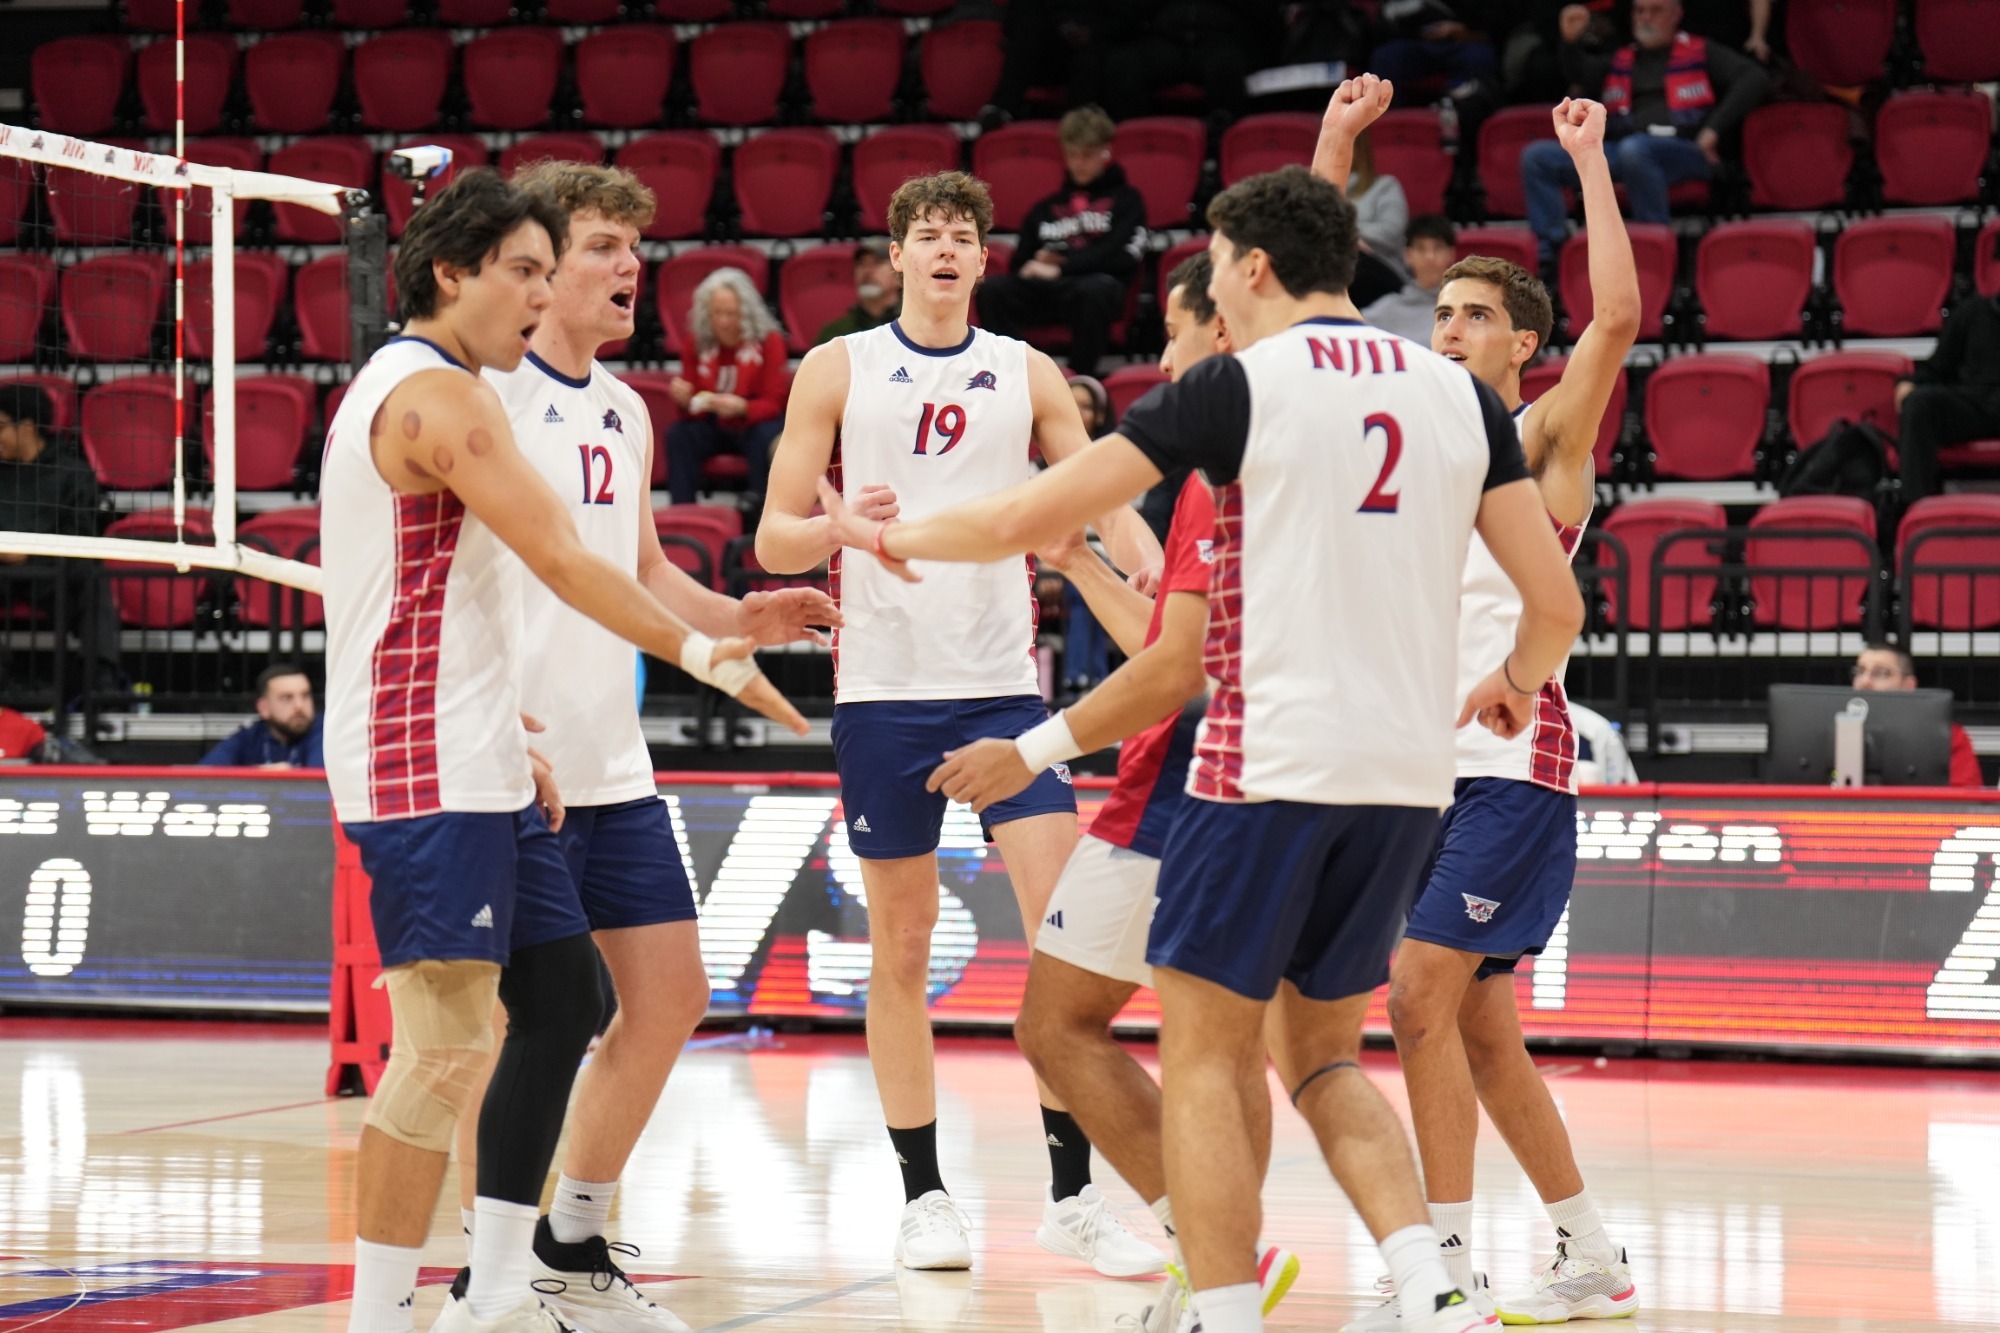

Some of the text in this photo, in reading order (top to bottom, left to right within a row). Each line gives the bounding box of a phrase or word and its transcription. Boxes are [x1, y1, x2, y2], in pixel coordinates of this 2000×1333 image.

[1306, 336, 1407, 378] NJIT
[912, 402, 967, 456] 19
[578, 444, 614, 504] 12
[1356, 411, 1404, 514] 2
[82, 791, 271, 837] Won
[21, 858, 92, 976] 0
